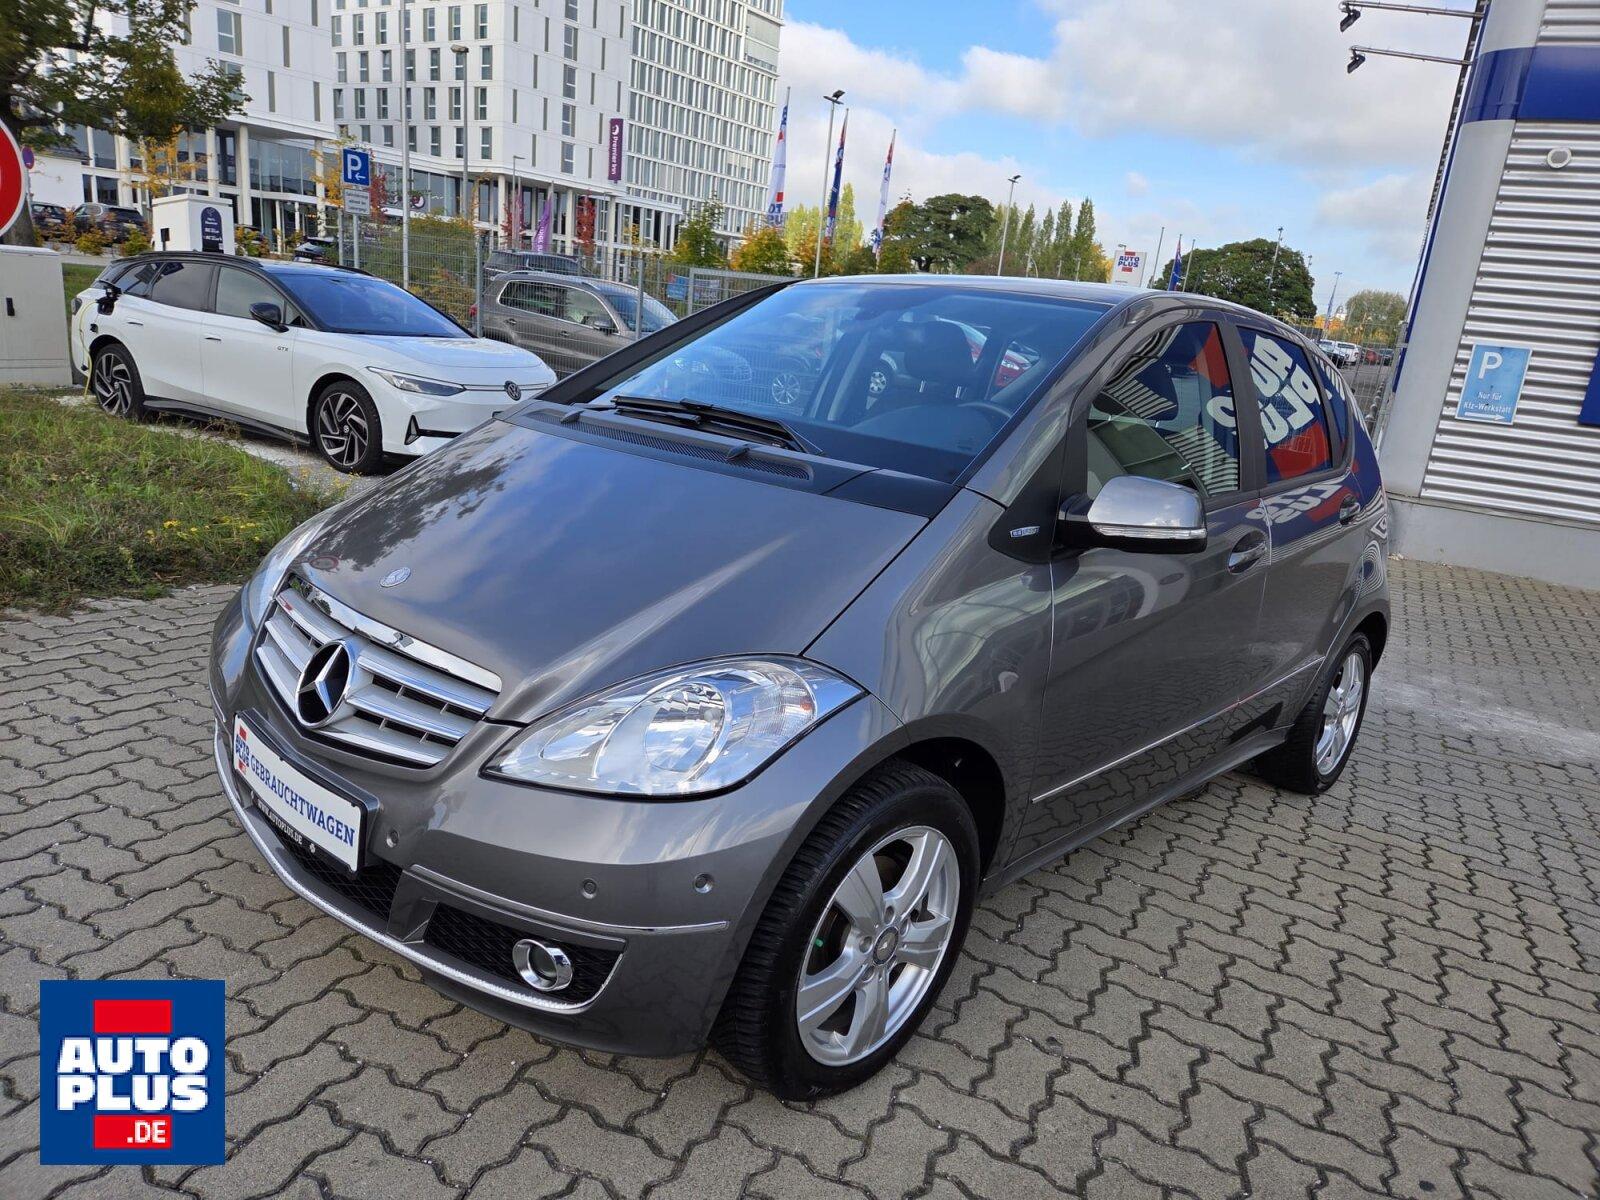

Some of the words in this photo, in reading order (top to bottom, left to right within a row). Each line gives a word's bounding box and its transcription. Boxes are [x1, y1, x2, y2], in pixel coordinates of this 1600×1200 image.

[611, 136, 619, 163] Premier
[347, 153, 362, 180] P
[1117, 260, 1139, 268] PLUS
[1478, 351, 1503, 379] P
[1463, 402, 1511, 414] Kfz-Werkstatt
[1478, 391, 1490, 400] Nur
[1491, 392, 1502, 401] für
[236, 733, 249, 757] AUTO
[236, 743, 249, 767] PLUS
[250, 755, 356, 848] GEBRAUCHTWAGEN
[258, 798, 303, 845] WWW.AUTOPLUS.DE
